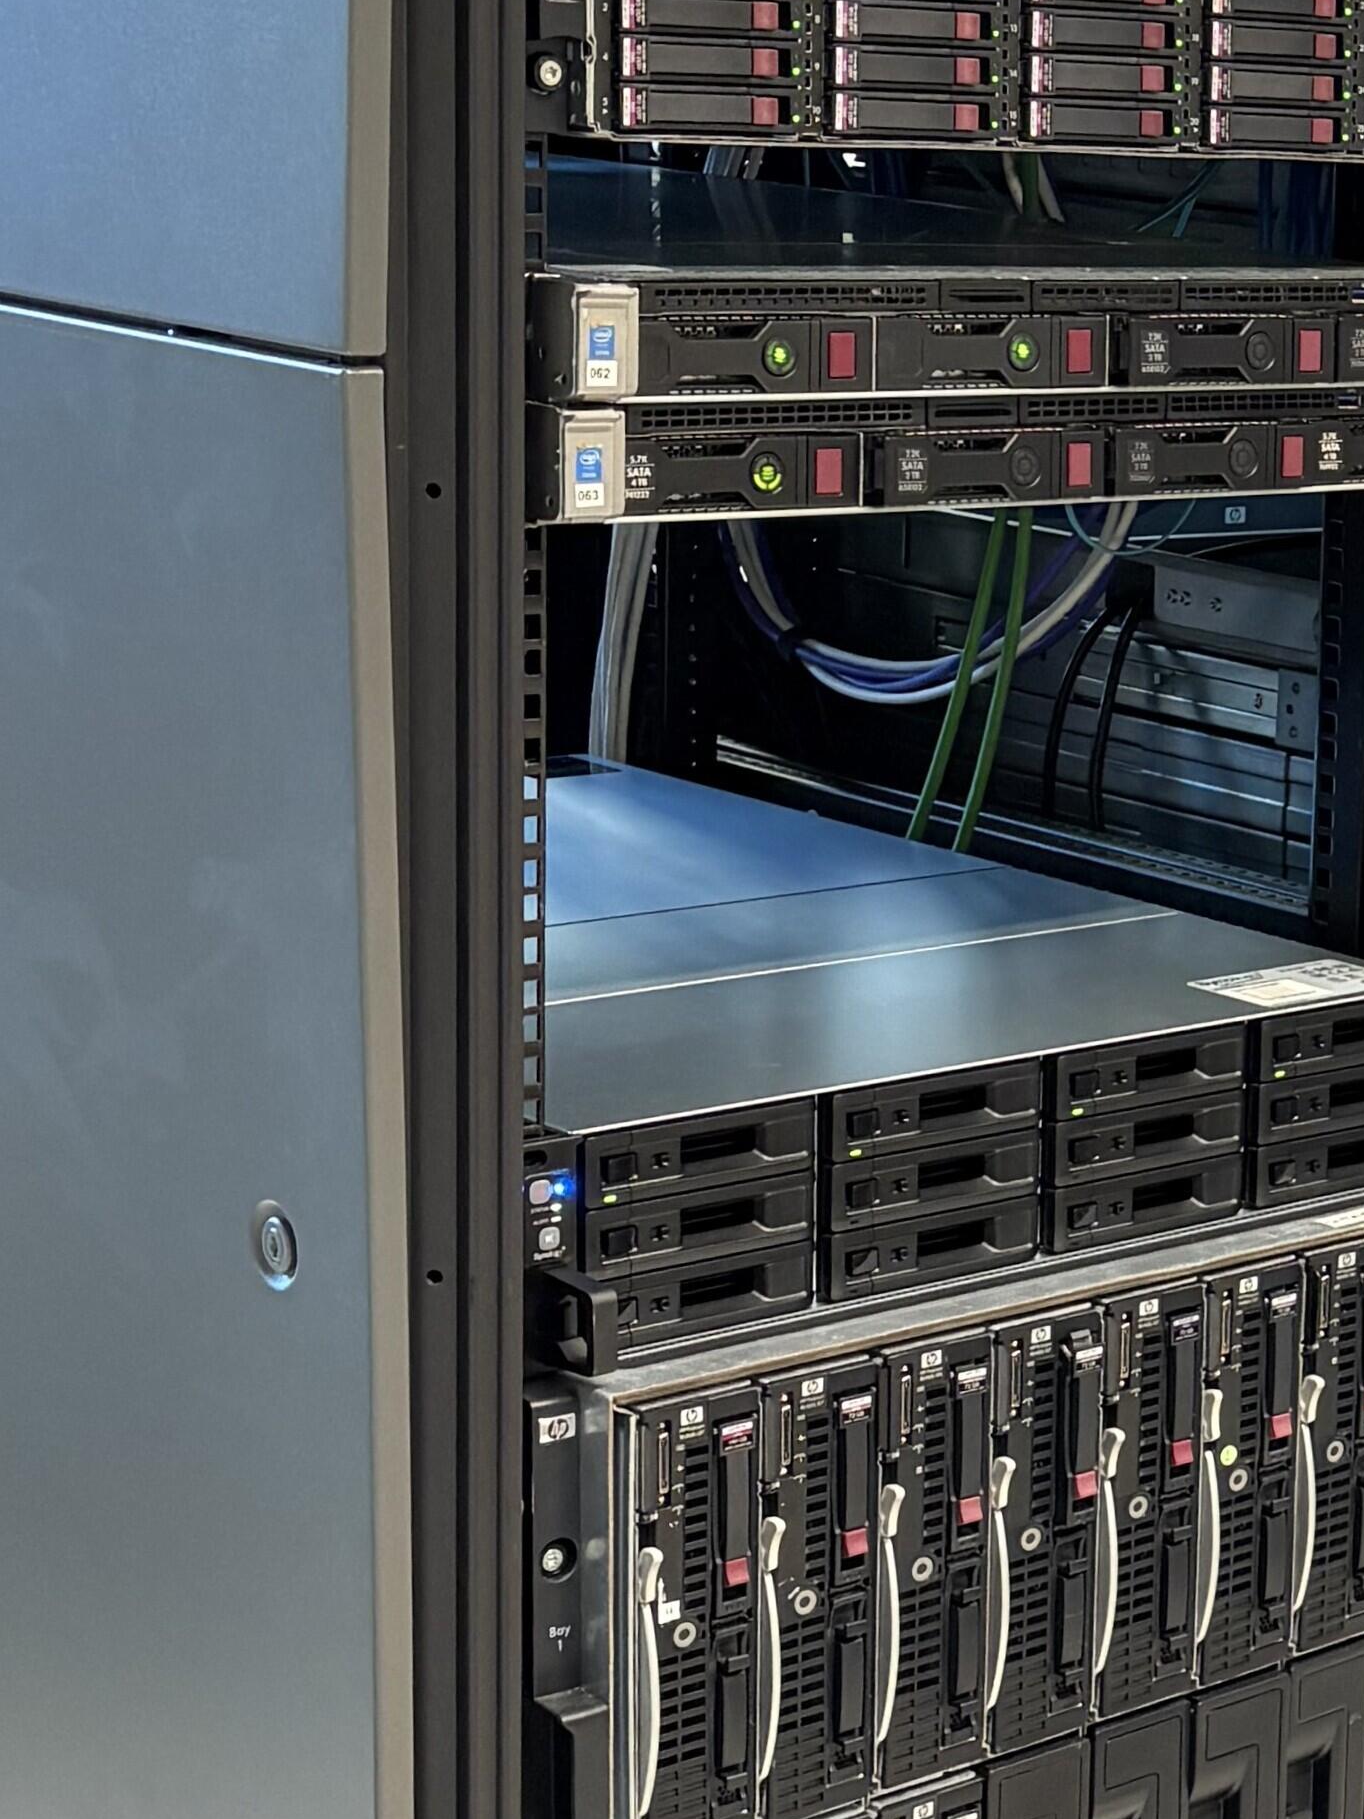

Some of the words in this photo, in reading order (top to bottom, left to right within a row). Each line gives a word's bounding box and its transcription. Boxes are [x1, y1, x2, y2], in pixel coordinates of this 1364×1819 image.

[901, 460, 924, 471] SATA
[626, 466, 652, 478] SATA
[578, 489, 599, 502] 063
[548, 1625, 572, 1638] Bay
